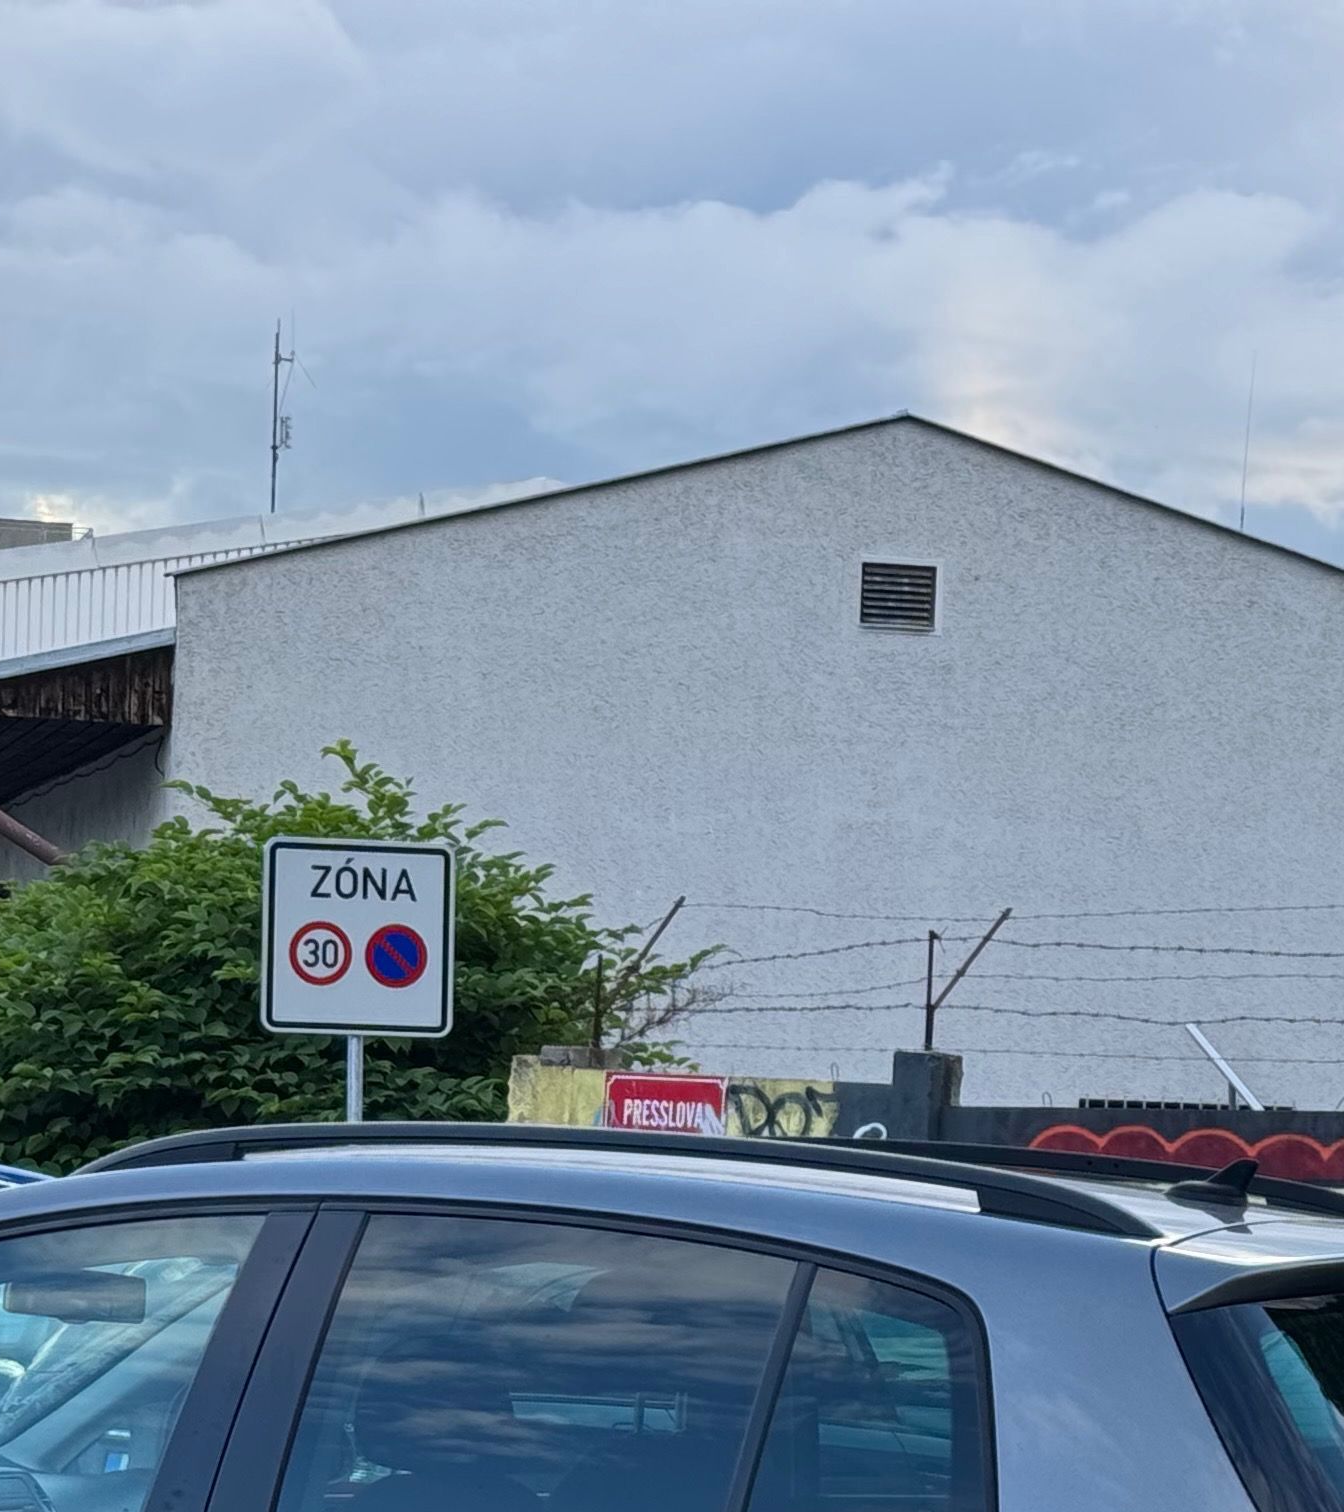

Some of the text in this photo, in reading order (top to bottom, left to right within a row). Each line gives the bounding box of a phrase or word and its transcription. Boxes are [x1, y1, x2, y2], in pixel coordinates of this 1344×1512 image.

[310, 857, 418, 902] ZÓNA
[302, 938, 339, 969] 30
[622, 1098, 704, 1129] PRESSLOVA
